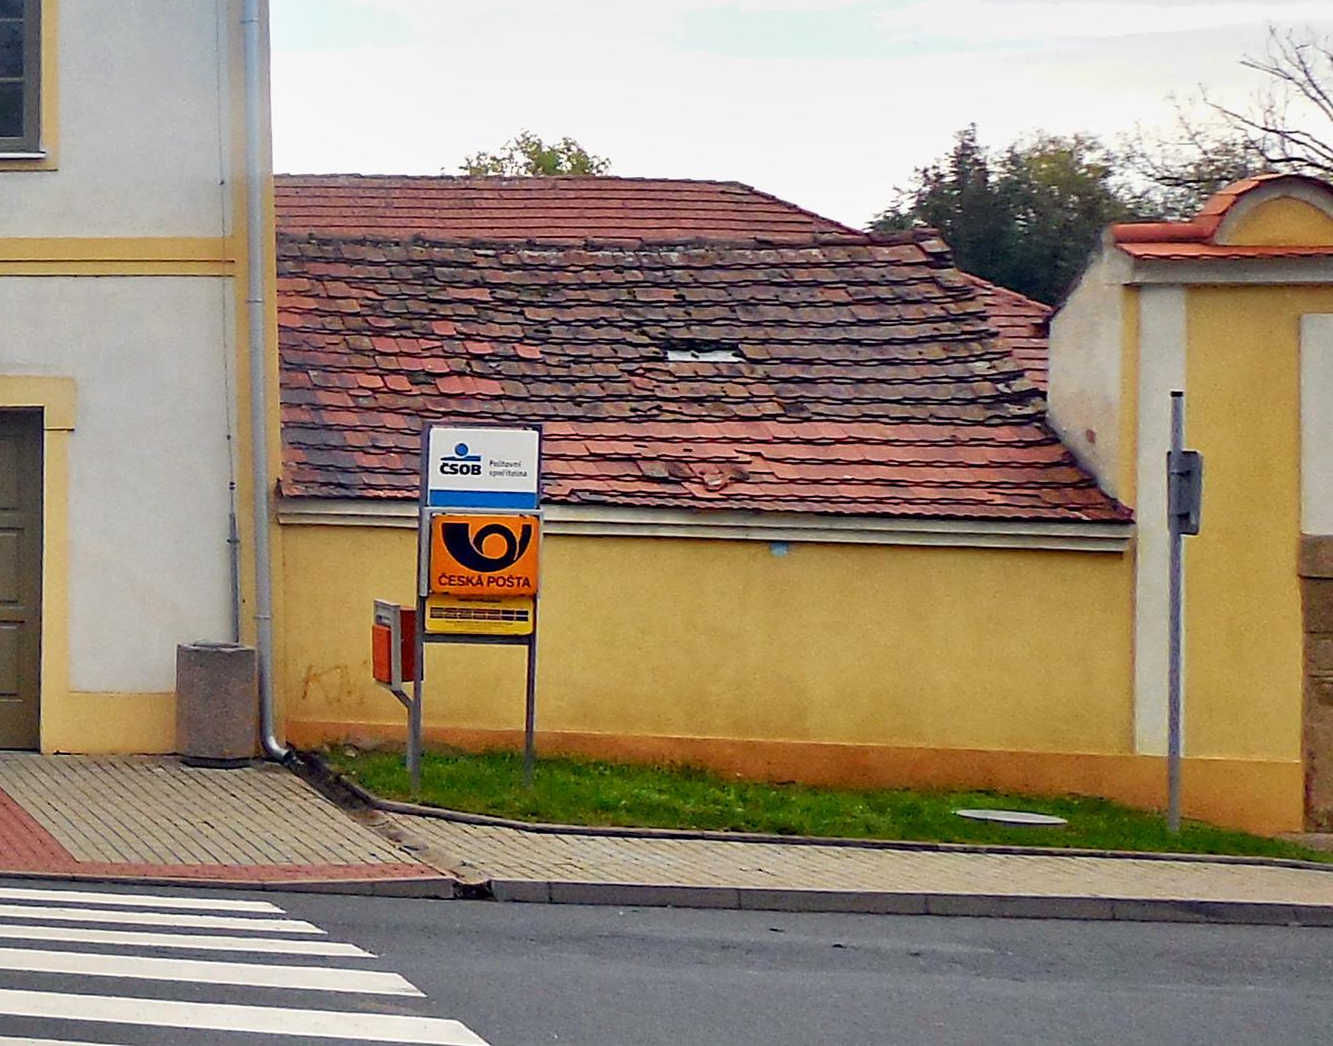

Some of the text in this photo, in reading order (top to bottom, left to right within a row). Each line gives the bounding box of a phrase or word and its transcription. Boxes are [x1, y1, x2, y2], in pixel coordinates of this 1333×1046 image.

[439, 462, 482, 475] ČSOB
[438, 573, 531, 588] ČESKÁ POŠTA
